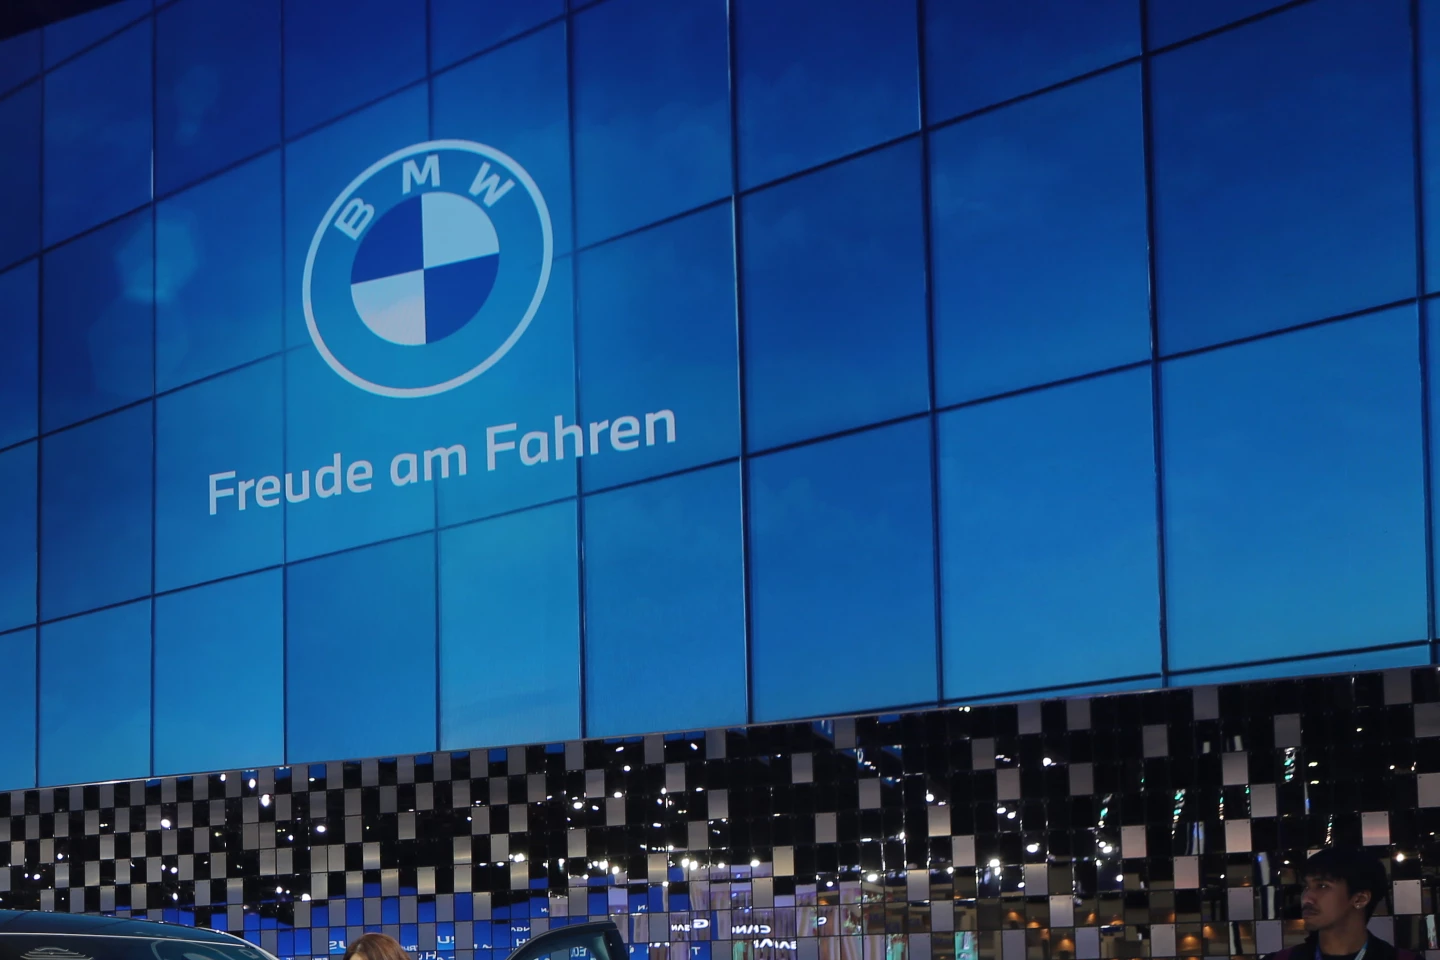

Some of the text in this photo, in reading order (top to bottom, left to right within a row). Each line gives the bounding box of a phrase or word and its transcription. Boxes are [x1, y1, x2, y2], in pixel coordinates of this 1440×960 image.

[334, 154, 516, 240] BMW
[209, 408, 676, 515] Freude am Fahren
